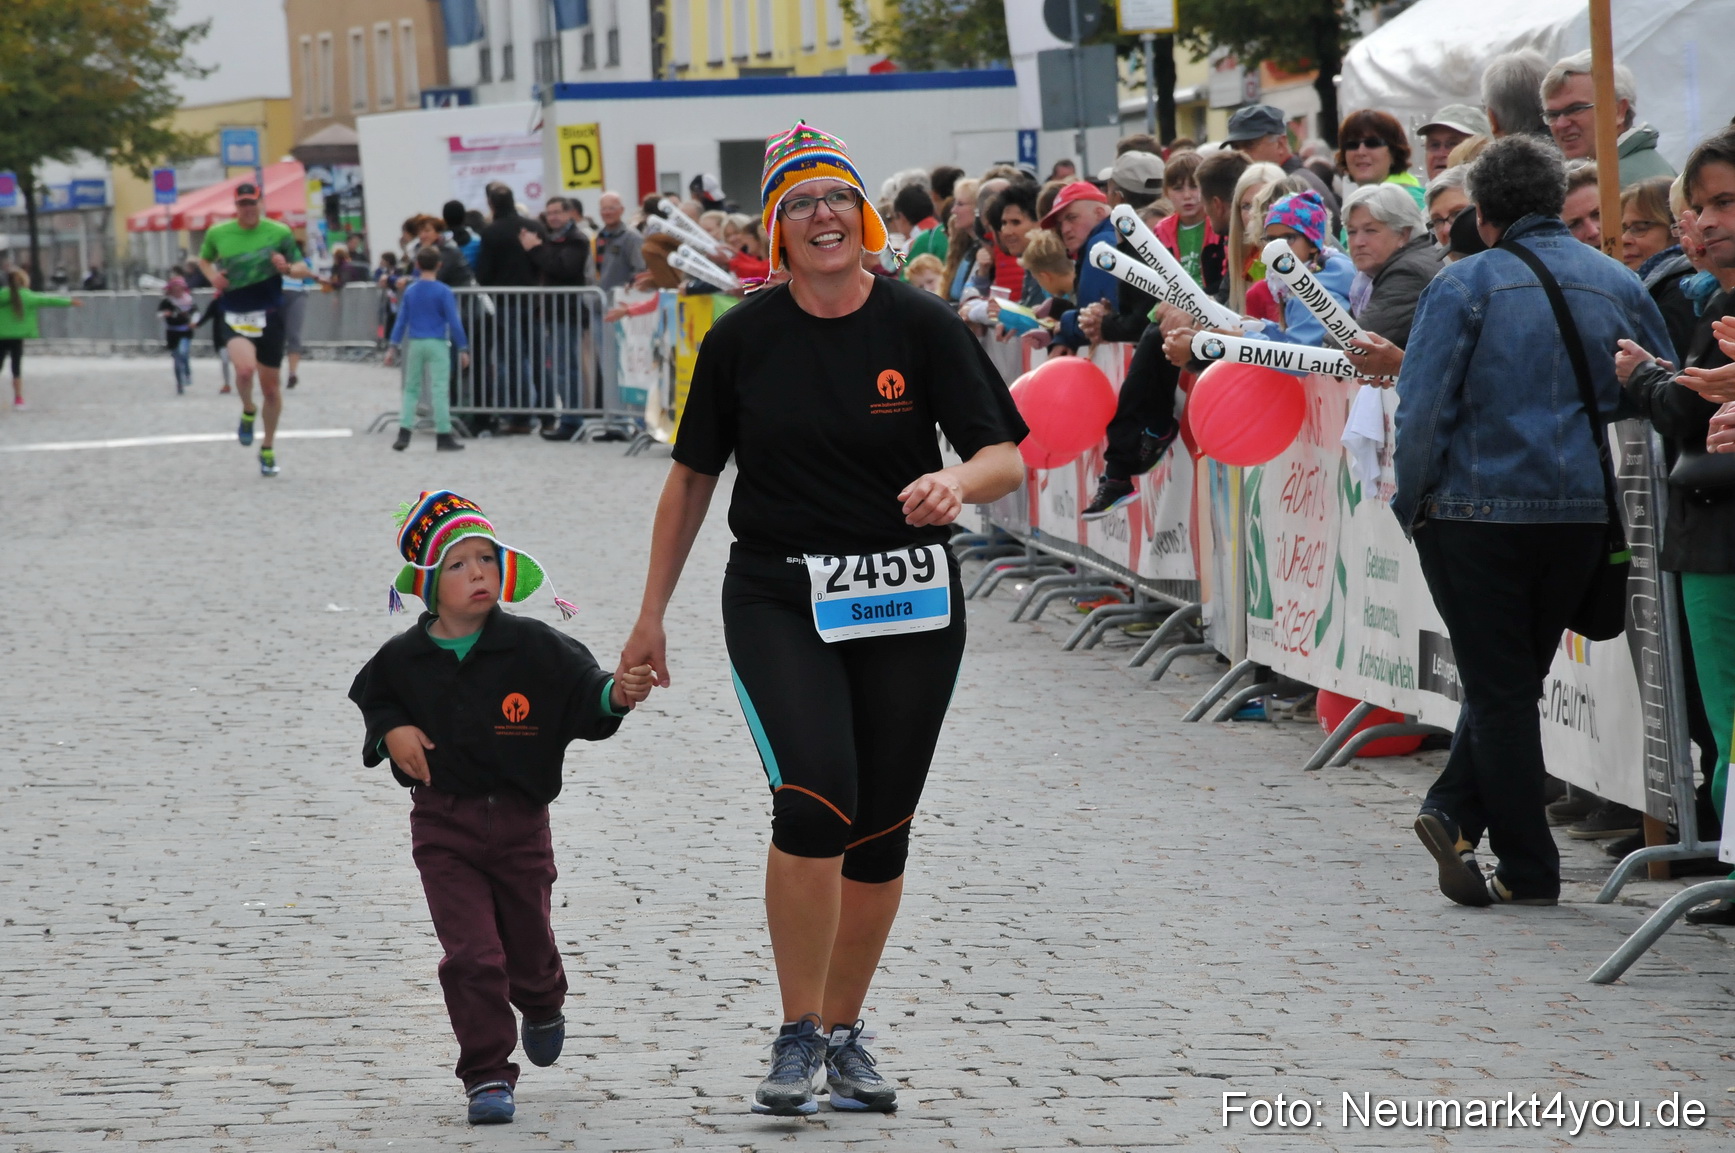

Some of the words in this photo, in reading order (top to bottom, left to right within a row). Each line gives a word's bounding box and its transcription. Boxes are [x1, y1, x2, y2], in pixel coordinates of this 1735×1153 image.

[562, 126, 596, 139] Block
[570, 144, 593, 175] D
[1291, 273, 1332, 312] BMW
[1322, 307, 1368, 356] Lauf
[1238, 345, 1293, 369] BMW
[823, 547, 936, 594] 2459
[817, 592, 823, 601] D
[852, 600, 913, 621] Sandra
